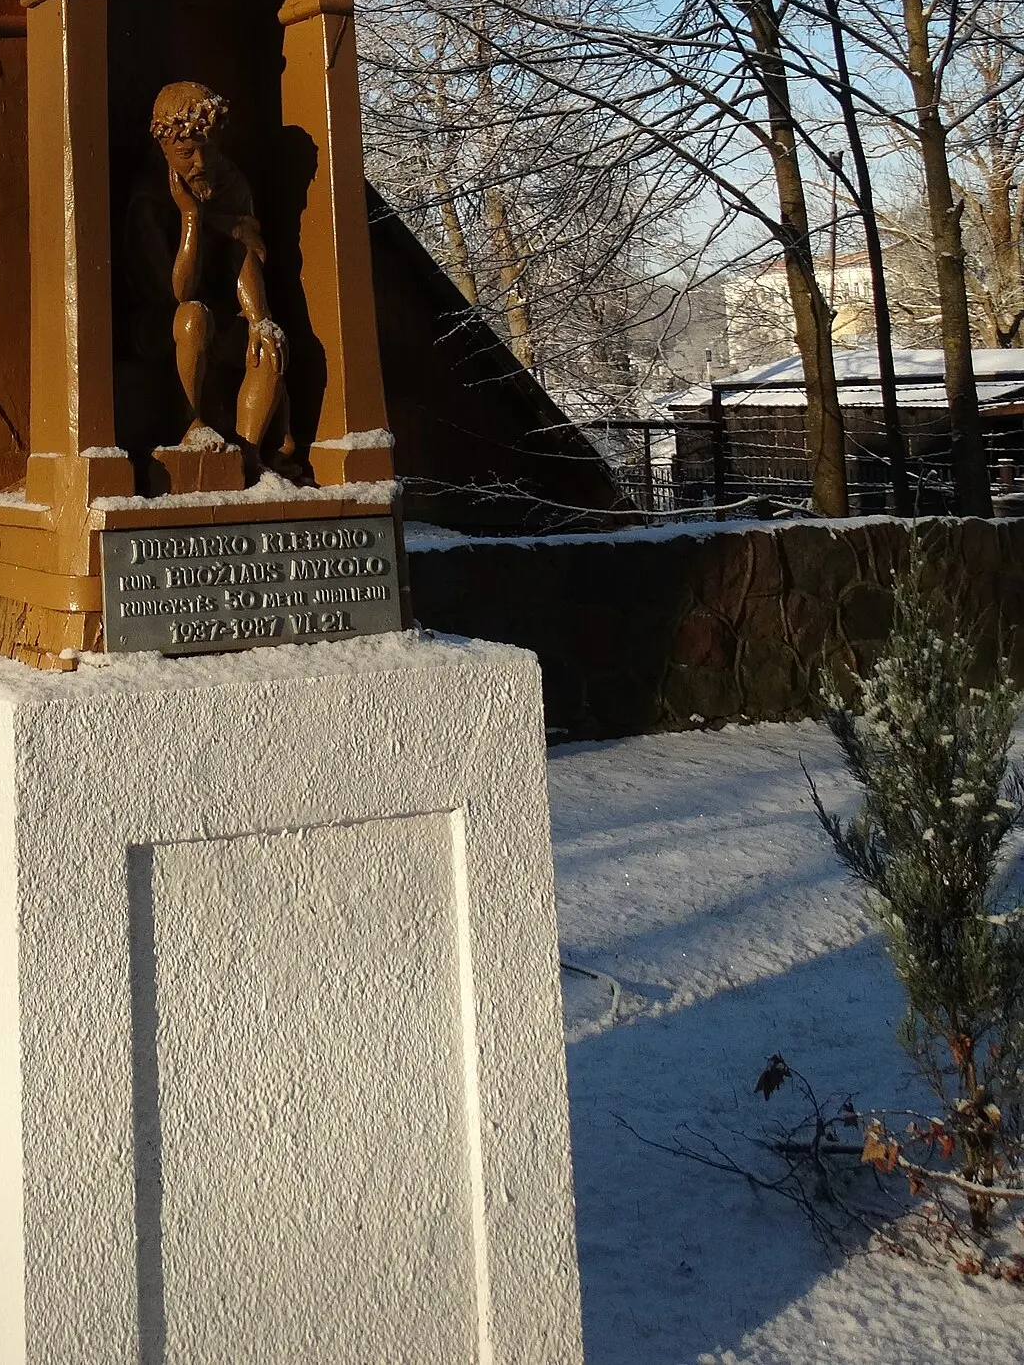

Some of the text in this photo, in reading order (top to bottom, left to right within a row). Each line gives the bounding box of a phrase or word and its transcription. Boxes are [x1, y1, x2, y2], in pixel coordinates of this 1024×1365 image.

[130, 529, 368, 564] JURBARKO KLEBONO
[119, 556, 383, 591] KUN. BUOŽIAUS MYKOLO
[224, 590, 255, 610] 50
[313, 585, 386, 603] JUBILIEJUI
[169, 615, 277, 644] 1937-1987
